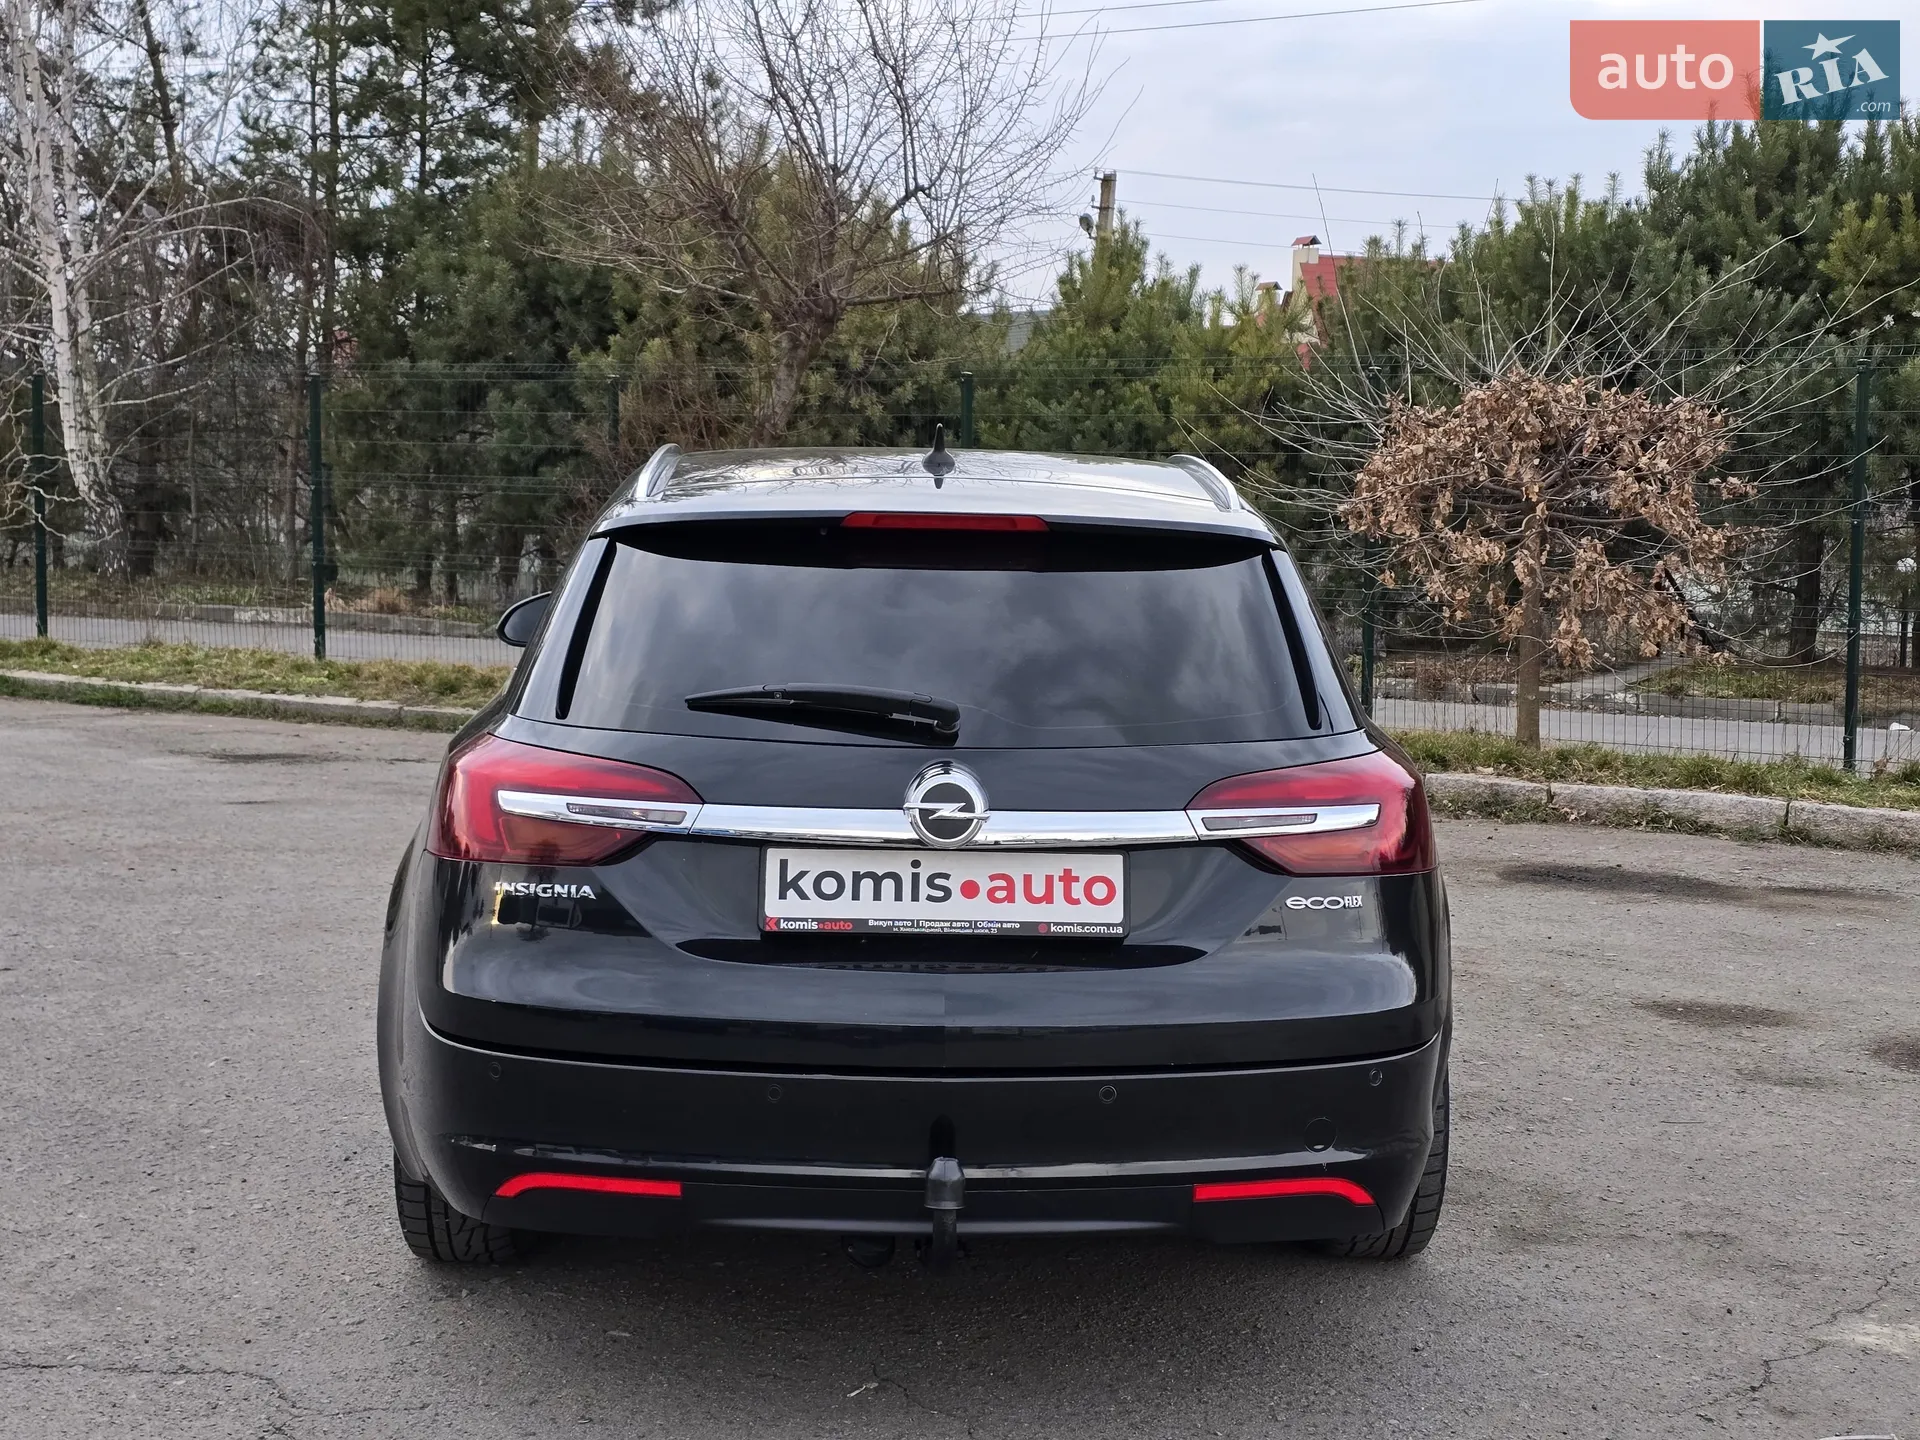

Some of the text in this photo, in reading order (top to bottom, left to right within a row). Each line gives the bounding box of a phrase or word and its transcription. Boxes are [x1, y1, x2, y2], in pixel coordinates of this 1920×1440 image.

[494, 881, 597, 900] INSIGNIA
[919, 920, 951, 928] Продаж
[1050, 923, 1123, 934] komis.com.ua
